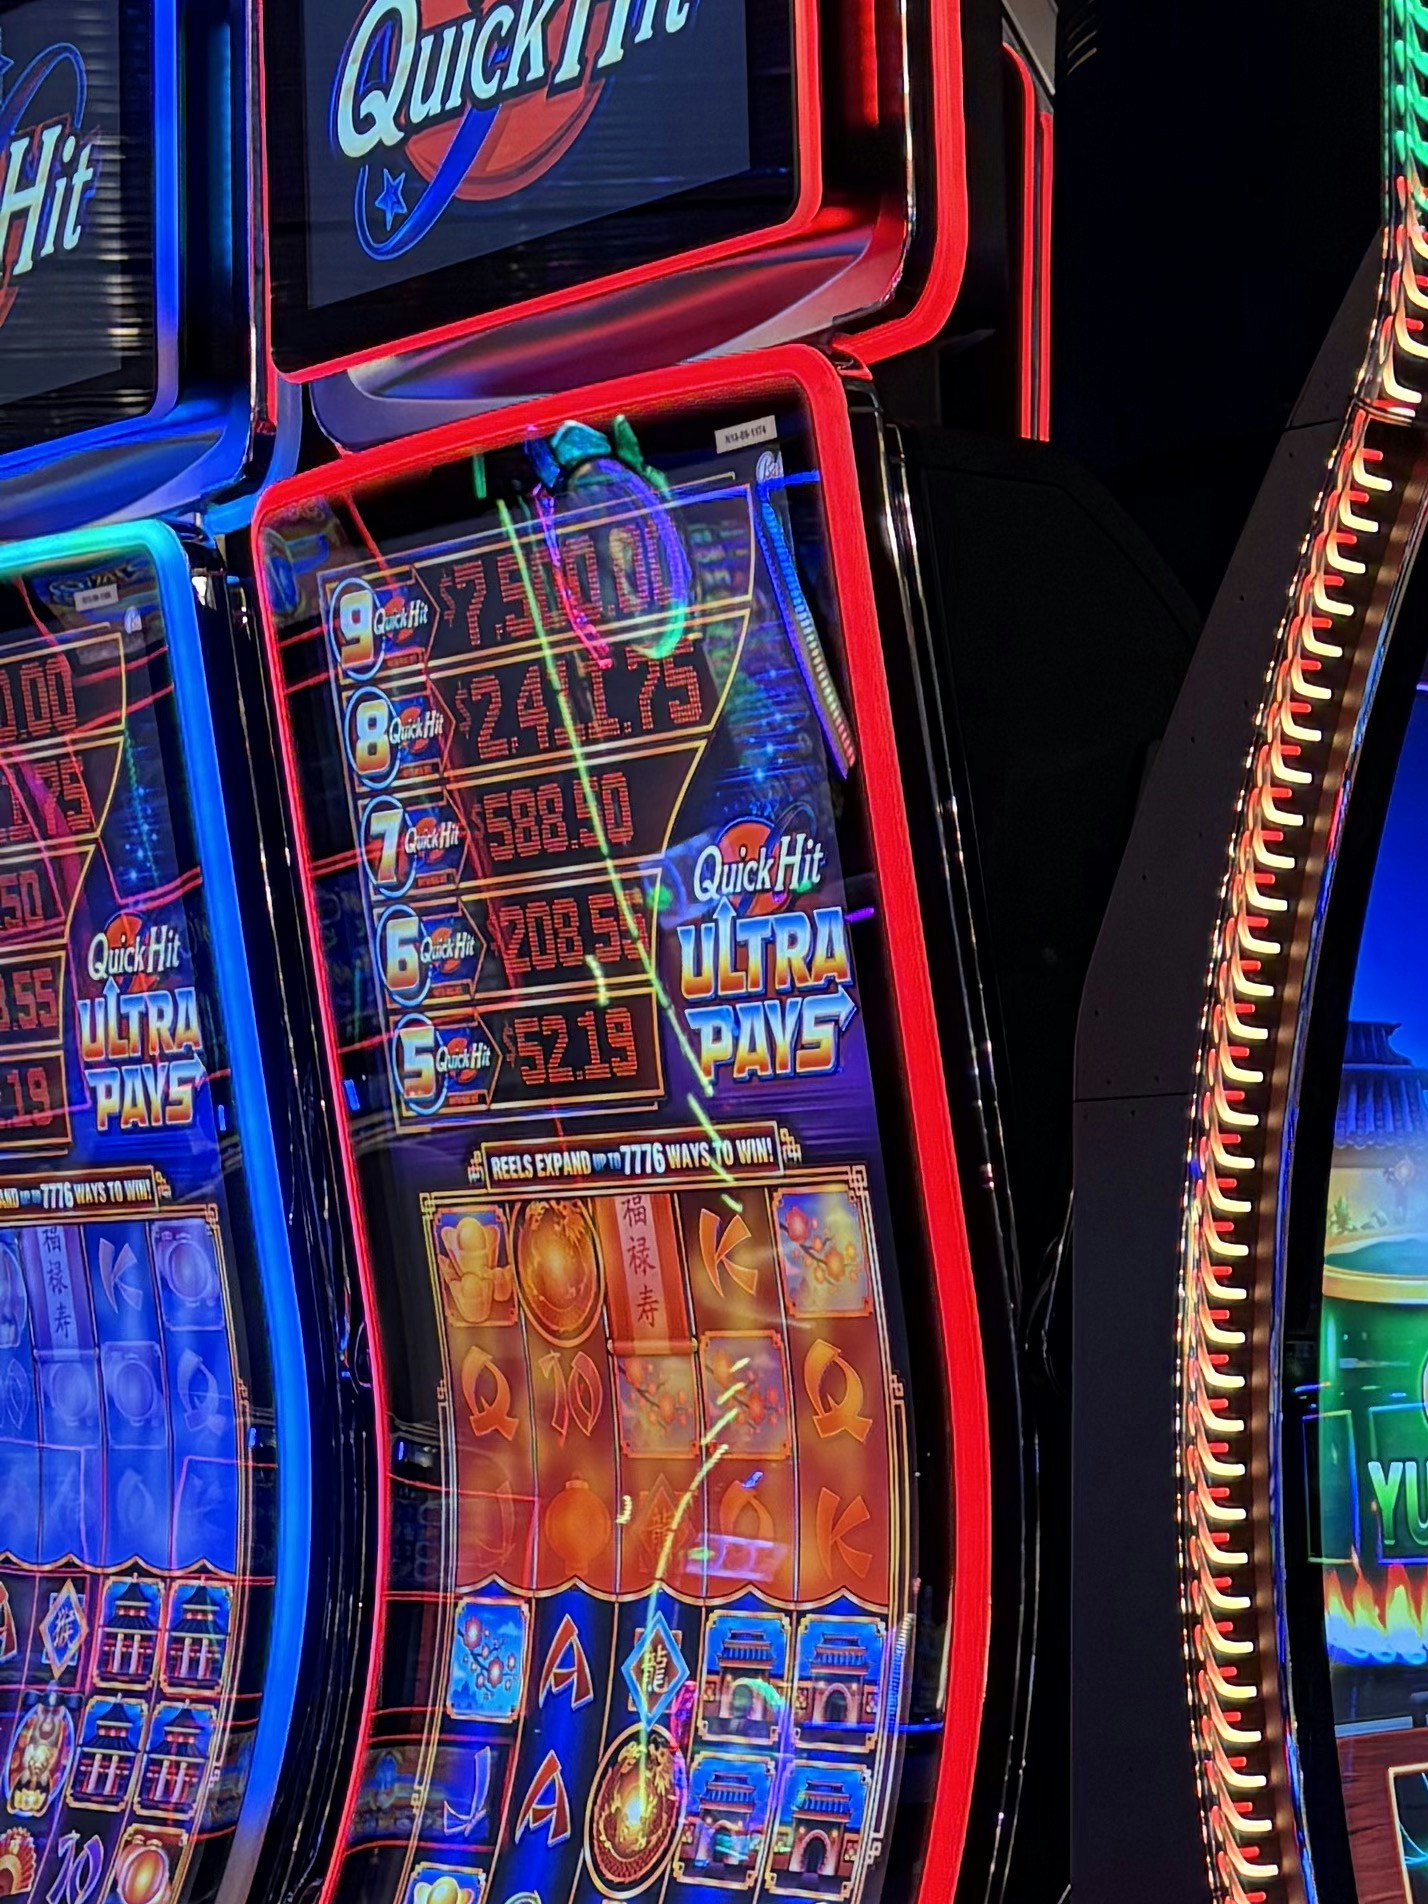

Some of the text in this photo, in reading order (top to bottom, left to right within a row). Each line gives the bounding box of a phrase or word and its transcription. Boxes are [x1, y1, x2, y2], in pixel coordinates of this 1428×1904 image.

[340, 589, 374, 668] 9
[407, 600, 429, 628] Hit
[356, 698, 391, 776] 8
[422, 709, 444, 740] Hit
[370, 808, 404, 886] 7
[437, 821, 460, 847] Hit
[694, 818, 826, 902] Quick Hit
[87, 924, 182, 983] Quick Hit
[386, 917, 420, 991] 6
[453, 931, 476, 959] Hit
[677, 901, 858, 1000] ULTRA
[78, 981, 203, 1062] ULTRA
[684, 986, 857, 1087] PAYS
[84, 1061, 207, 1133] PAYS
[399, 1025, 436, 1099] 5
[468, 1041, 493, 1069] Hit
[40, 1181, 74, 1210] 7776
[74, 1180, 107, 1207] WAYS
[107, 1179, 124, 1203] TO
[123, 1177, 153, 1202] WIN!
[490, 1153, 534, 1181] REELS
[535, 1149, 593, 1178] EXPAND
[619, 1142, 666, 1176] 7776
[664, 1140, 710, 1170] WAYS
[734, 1136, 774, 1164] WIN!
[98, 1237, 144, 1314] K
[699, 1208, 759, 1298] K
[461, 1346, 519, 1441] Q
[537, 1350, 603, 1447] 10
[804, 1338, 873, 1444] Q
[538, 1613, 594, 1712] A
[514, 1749, 571, 1848] A
